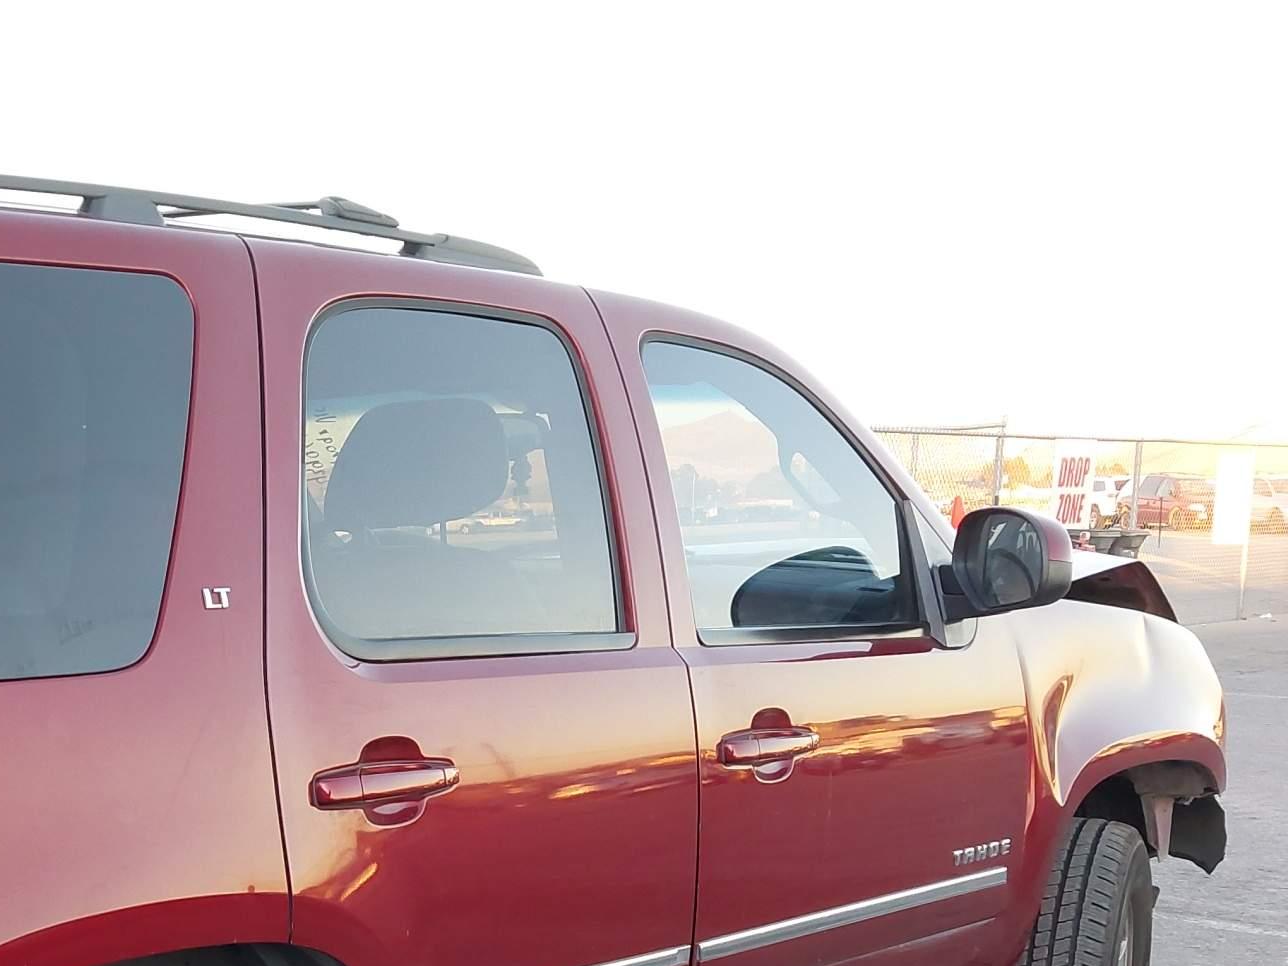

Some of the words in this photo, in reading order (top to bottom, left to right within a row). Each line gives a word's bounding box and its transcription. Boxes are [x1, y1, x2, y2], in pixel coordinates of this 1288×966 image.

[1058, 457, 1091, 488] DROP
[1056, 493, 1087, 525] ZONE
[202, 587, 231, 609] LT
[952, 838, 1011, 866] TAHOE
